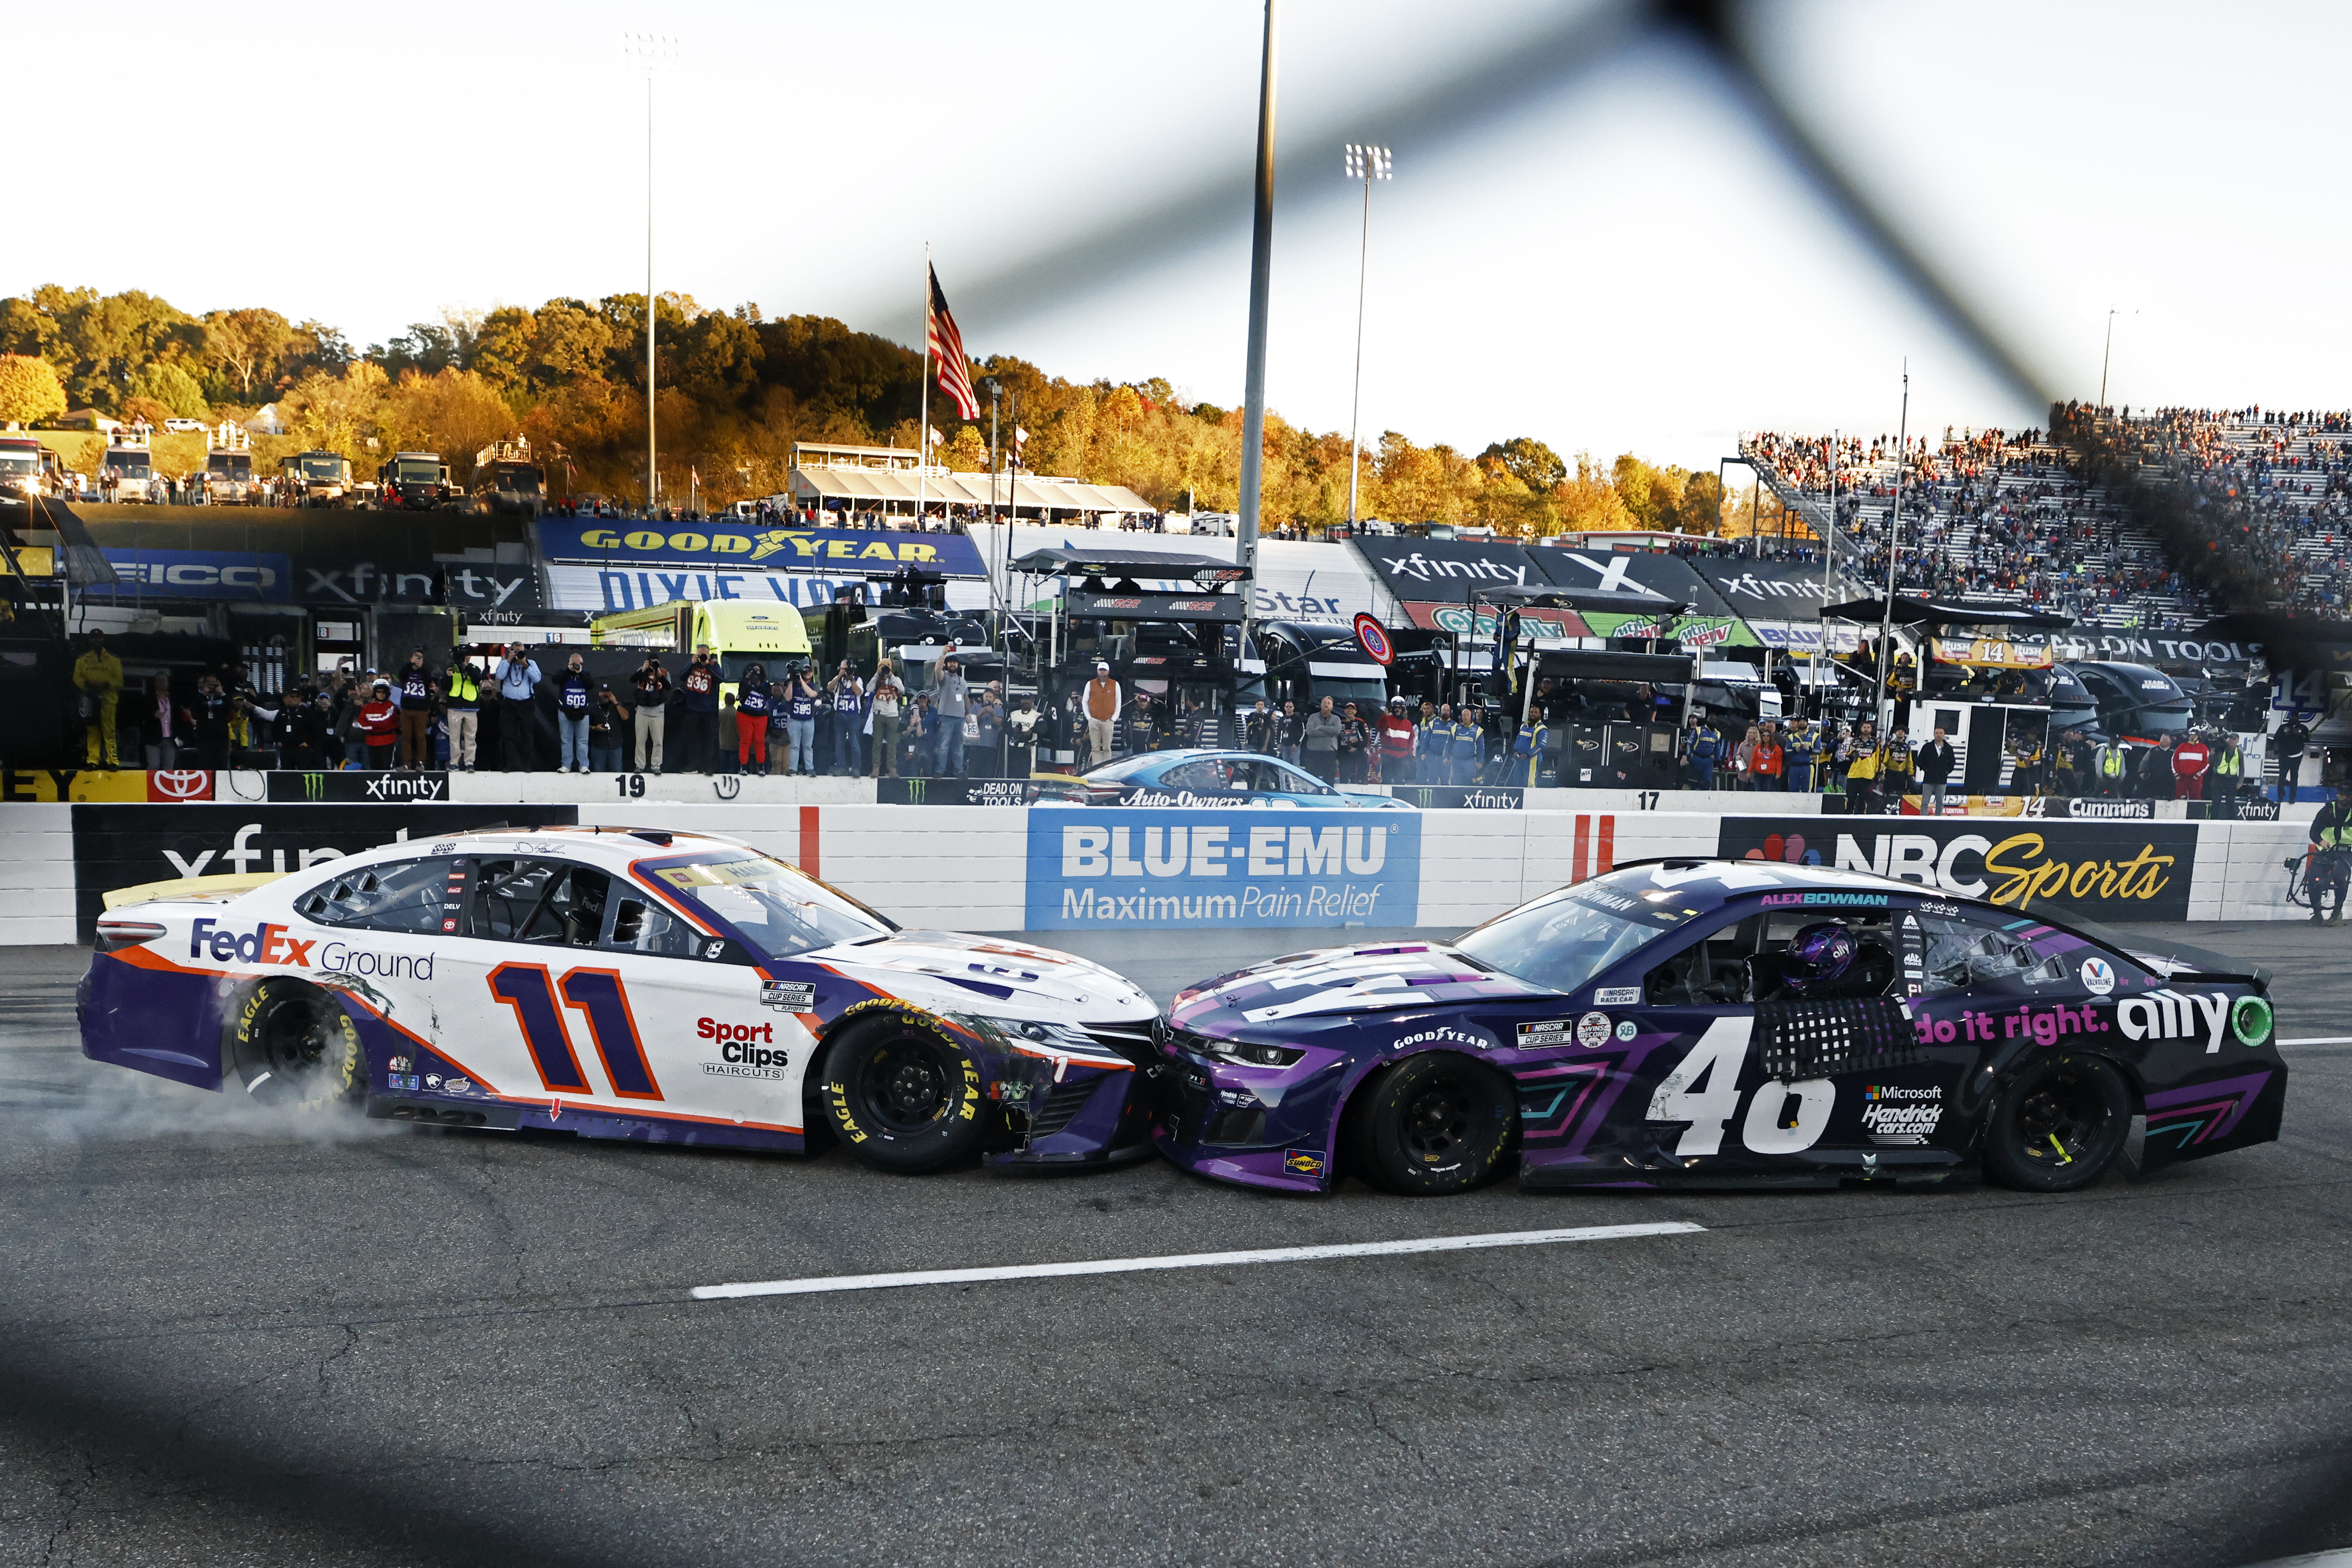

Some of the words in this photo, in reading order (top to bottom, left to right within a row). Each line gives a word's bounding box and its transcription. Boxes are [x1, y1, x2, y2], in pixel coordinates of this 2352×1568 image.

[1213, 570, 1244, 580] RCR
[1381, 553, 1525, 585] xfinity
[1111, 599, 1141, 608] RCR
[1187, 601, 1216, 611] RCR
[548, 633, 561, 643] 16
[1942, 640, 1971, 652] RUSH
[1981, 642, 2004, 662] 14
[2014, 644, 2043, 657] RUSH
[687, 675, 708, 692] 936
[367, 775, 443, 800] xfinity
[615, 775, 645, 796] 19
[983, 783, 1007, 795] DEAD
[1009, 783, 1023, 795] ON
[983, 796, 1022, 806] TOOLS
[1120, 788, 1243, 807] Auto-Owners
[1463, 790, 1519, 809] xfinity
[1639, 791, 1660, 810] 17
[2017, 796, 2046, 818] 14
[2069, 797, 2149, 817] Cummins
[2237, 802, 2278, 821] xfinity
[1062, 826, 1386, 876] BLUE-EMU
[1834, 833, 1992, 898] NBC
[1985, 832, 2175, 911] Sports
[1062, 887, 1236, 920] Maximum
[1240, 886, 1301, 918] Pain
[1305, 883, 1384, 918] Relief
[190, 918, 317, 968] FedEx
[321, 942, 435, 980] Ground
[707, 940, 725, 959] 8
[1833, 940, 1849, 959] ally
[1904, 953, 1922, 962] MAC
[778, 983, 808, 992] NASCAR
[2085, 977, 2112, 986] VALVOLINE
[782, 993, 807, 1002] SERIES
[238, 985, 269, 1043] EAGLE
[2117, 988, 2229, 1054] ally
[486, 961, 665, 1102] 11
[697, 1017, 773, 1044] Sport
[1534, 1023, 1564, 1032] NASCAR
[1915, 1013, 1957, 1044] do
[1963, 1011, 1995, 1041] it
[2004, 1004, 2109, 1046] right.
[1525, 1035, 1539, 1044] CUP
[1539, 1034, 1564, 1042] SERIES
[722, 1041, 788, 1068] Clips
[706, 1065, 780, 1078] HAIRCUTS
[1220, 1090, 1237, 1099] Hendrick
[1644, 1016, 1836, 1156] 48
[1881, 1085, 1942, 1099] Microsoft
[831, 1081, 868, 1143] EAGLE
[1861, 1104, 1943, 1128] Hendrick
[1876, 1122, 1936, 1133] cars.com
[1287, 1158, 1322, 1169] SUNOCO
